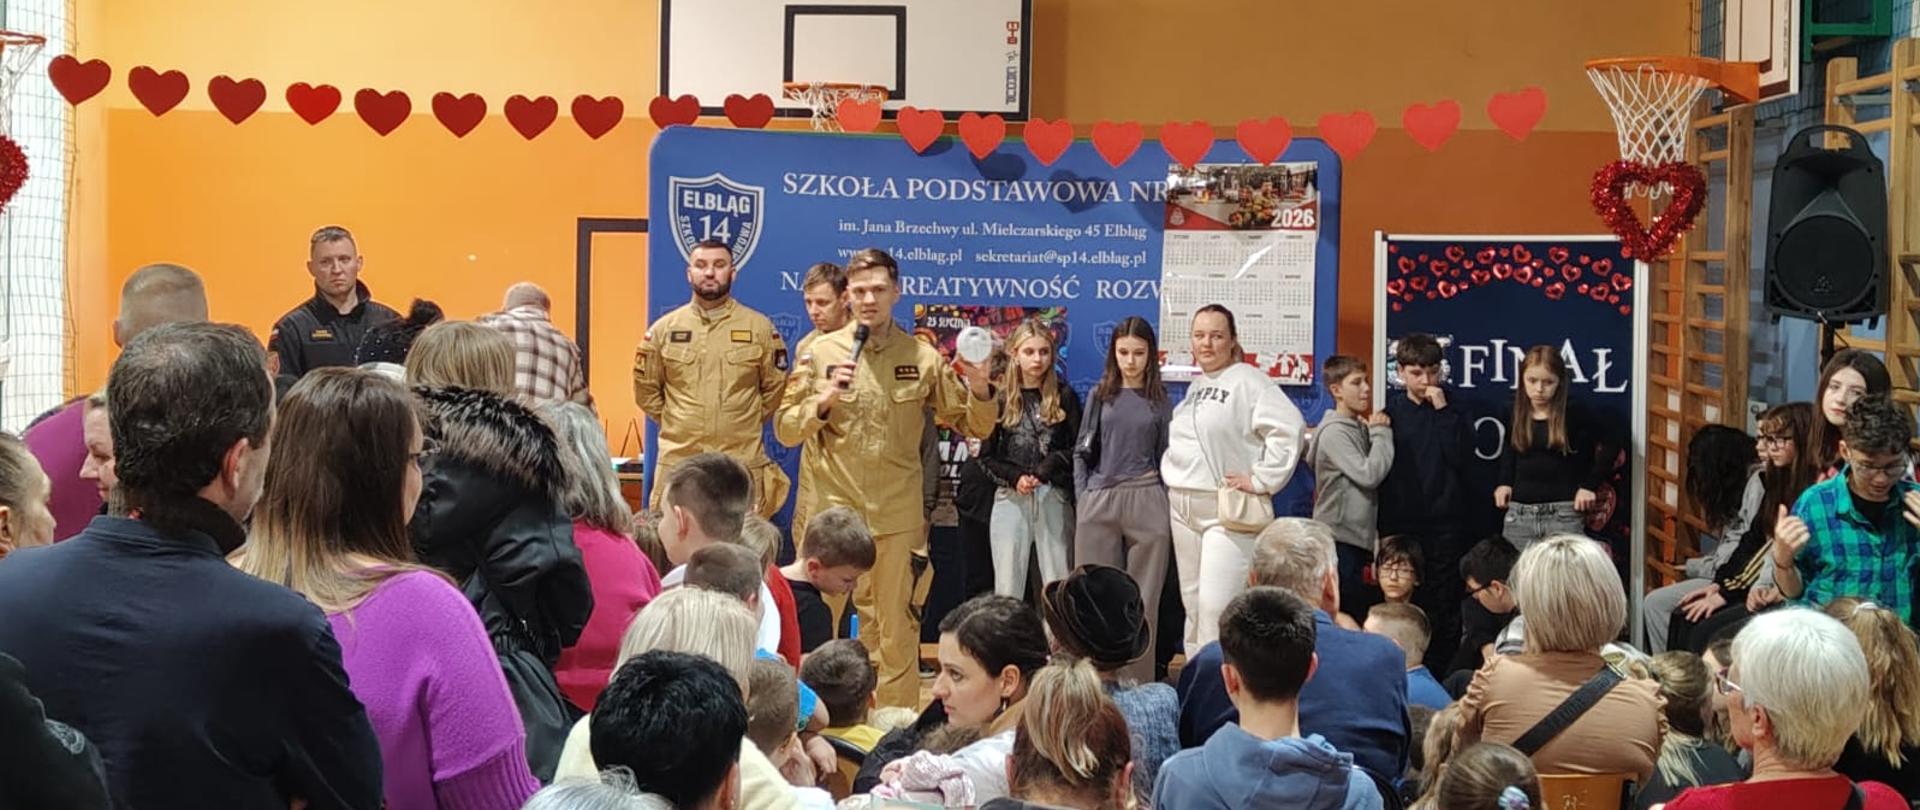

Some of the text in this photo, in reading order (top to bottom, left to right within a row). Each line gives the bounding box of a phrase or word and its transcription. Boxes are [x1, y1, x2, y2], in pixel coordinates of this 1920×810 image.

[783, 172, 1168, 203] SZKOŁA PODSTAWOWA NR
[683, 190, 751, 218] ELBLĄG
[699, 215, 731, 243] 14
[839, 219, 1147, 241] im. Jana Brzechwy ul. Mielczarskiego 45 Elbląg
[1271, 208, 1316, 228] 2026
[975, 249, 1147, 268] sekretariat@sp14.elblag.pl
[901, 275, 1080, 299] REATYWNOŚĆ
